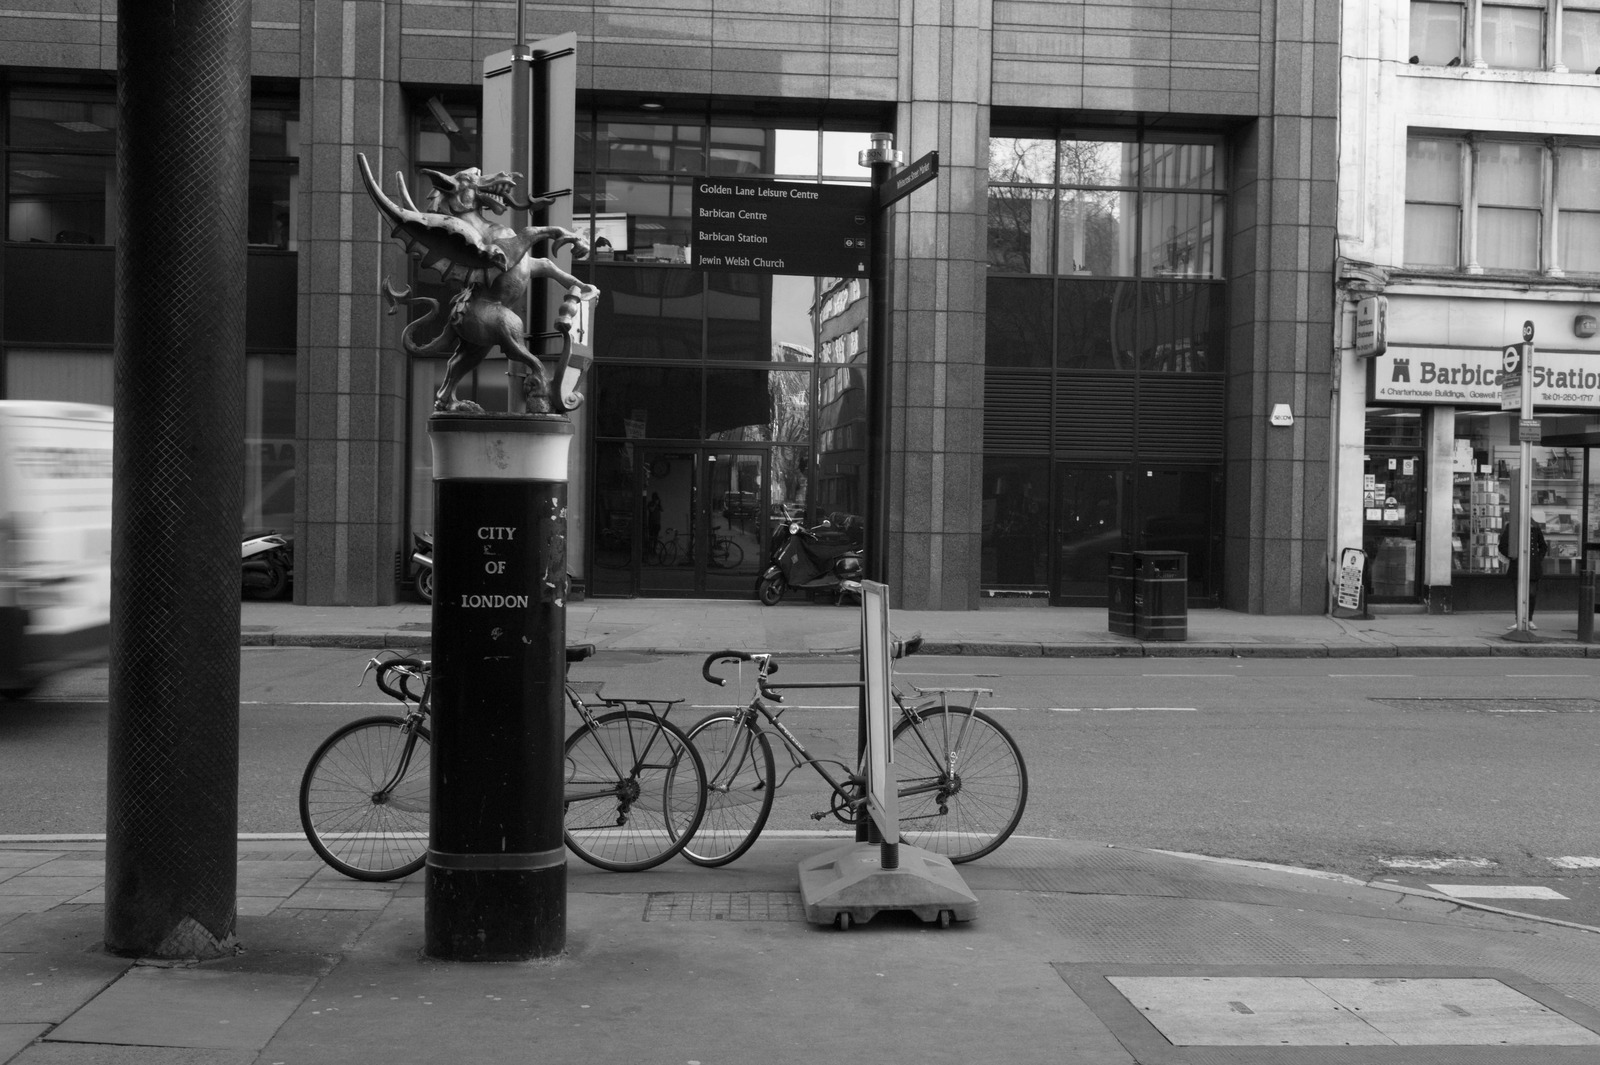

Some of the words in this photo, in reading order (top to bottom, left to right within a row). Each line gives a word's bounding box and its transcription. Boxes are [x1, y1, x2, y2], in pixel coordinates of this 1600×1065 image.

[700, 184, 731, 195] Golden
[736, 186, 755, 196] Lane
[758, 187, 787, 198] Leisure
[790, 188, 818, 200] Centre
[700, 208, 735, 219] Barbican
[738, 210, 767, 220] Centre
[700, 231, 734, 242] Barbican
[738, 233, 768, 244] Station
[698, 255, 722, 266] Jewin
[724, 256, 750, 266] Welsh
[753, 258, 784, 268] Church
[1420, 362, 1502, 386] Barbica
[1387, 387, 1433, 397] Charterhouse
[1469, 390, 1496, 399] Goswell
[478, 526, 516, 540] CITY
[484, 561, 506, 574] OF
[461, 595, 528, 608] LONDON
